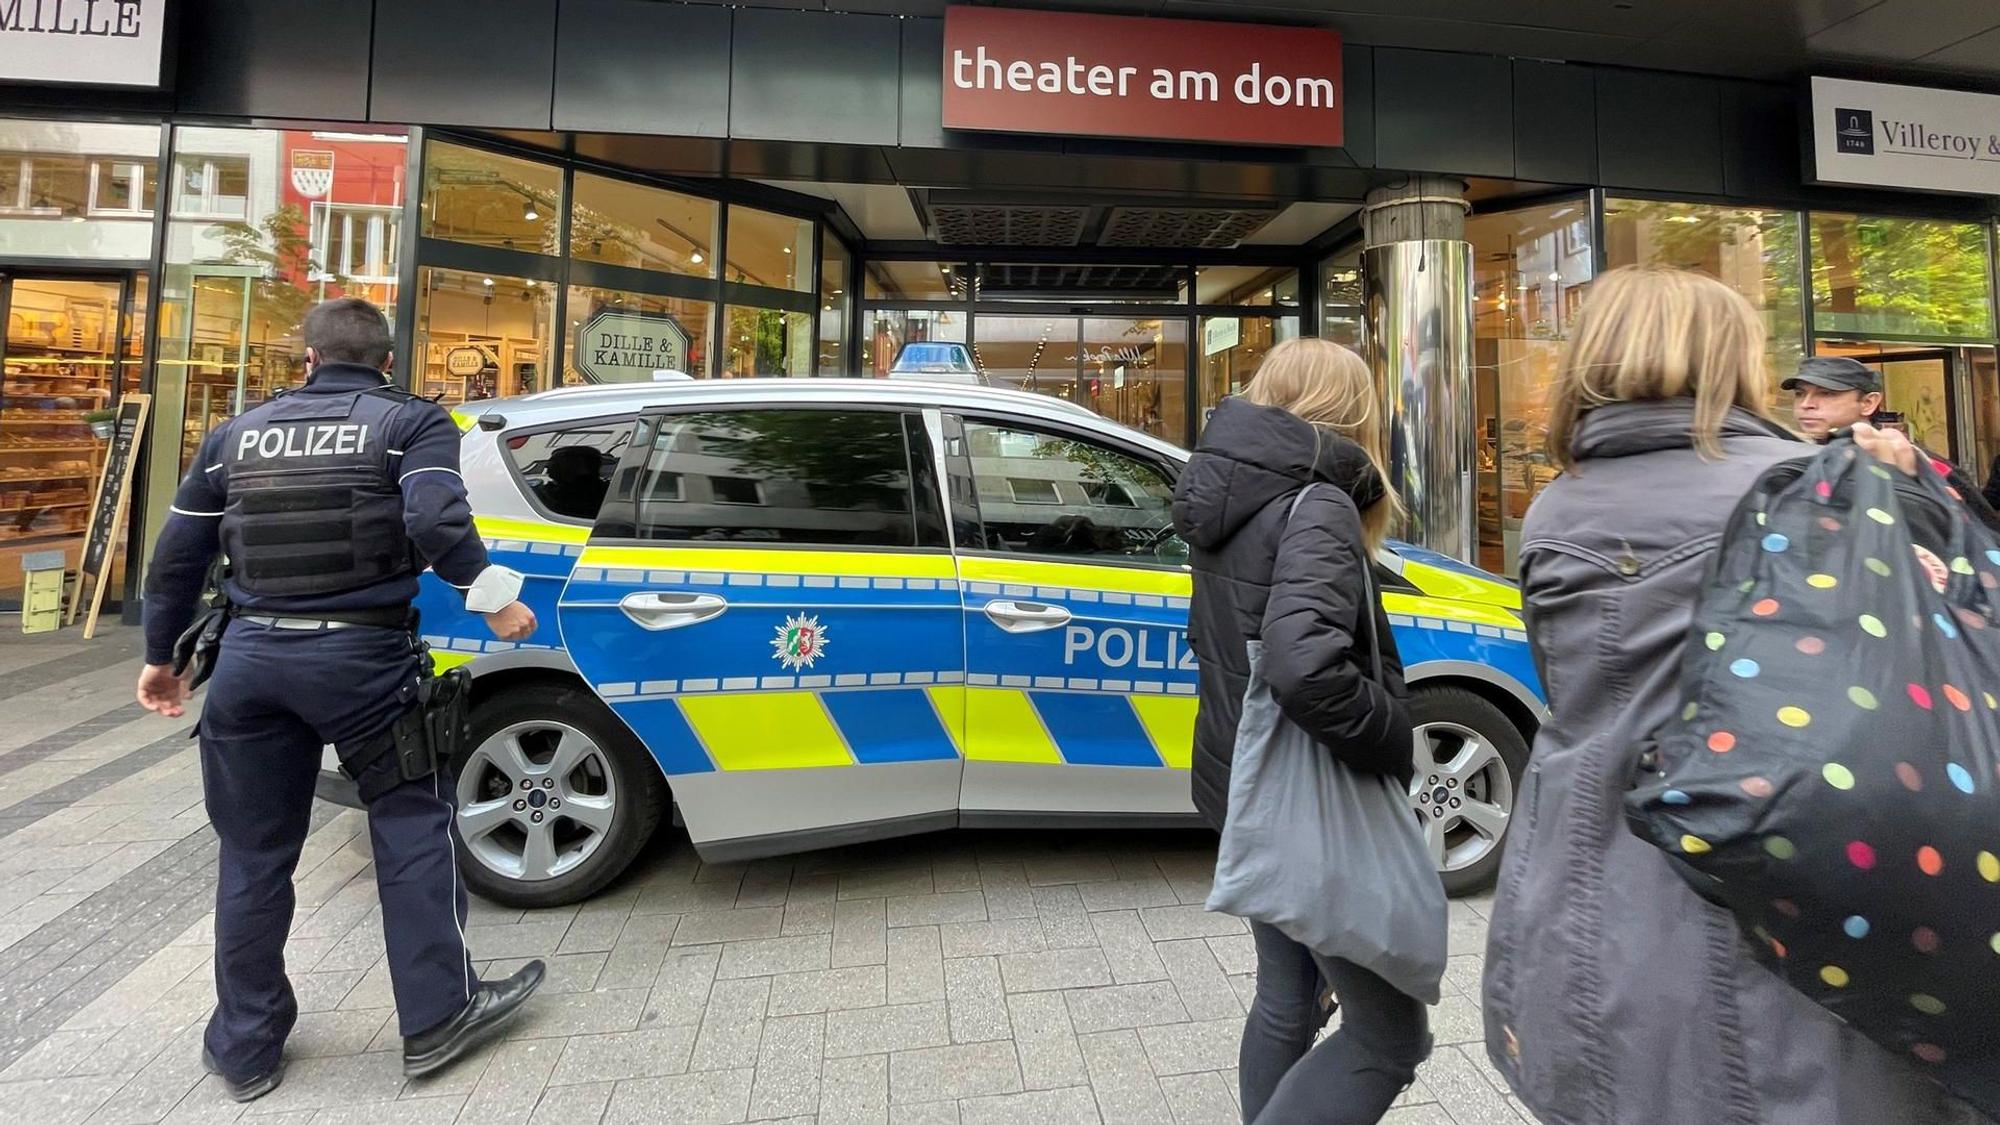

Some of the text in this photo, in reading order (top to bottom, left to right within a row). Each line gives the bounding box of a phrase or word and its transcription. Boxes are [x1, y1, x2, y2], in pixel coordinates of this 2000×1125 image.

[953, 46, 1334, 108] theater am dom
[1881, 120, 1981, 160] Villeroy
[594, 350, 676, 369] KAMILLE
[600, 333, 672, 352] DILLE &
[237, 424, 368, 461] POLIZEI
